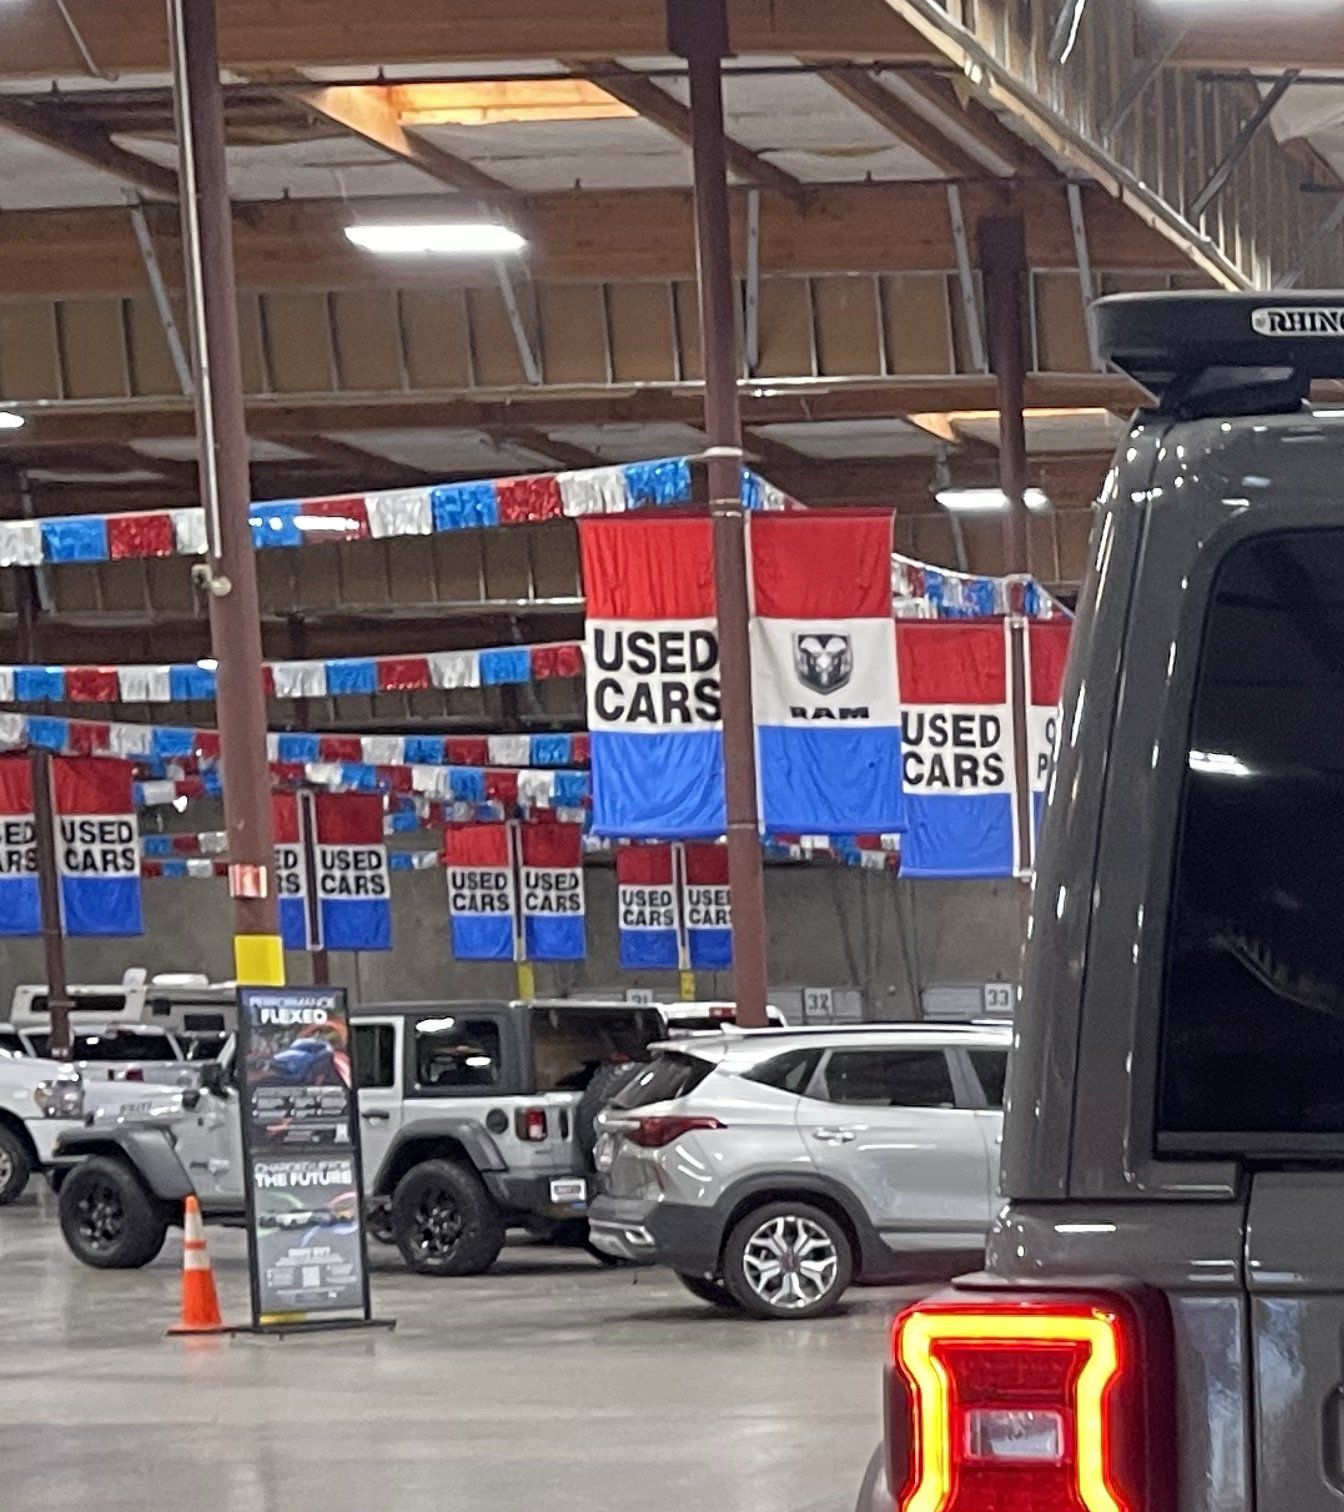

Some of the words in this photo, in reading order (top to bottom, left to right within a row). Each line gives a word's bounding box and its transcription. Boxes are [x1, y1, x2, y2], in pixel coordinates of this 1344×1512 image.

[594, 627, 720, 675] USED
[594, 677, 722, 724] CARS
[790, 706, 870, 719] RAM
[900, 711, 1001, 748] USED
[902, 751, 1005, 788] CARS
[60, 820, 134, 844] USED
[65, 849, 136, 872] CARS
[320, 850, 382, 871] USED
[320, 874, 386, 895] CARS
[452, 871, 508, 891] USED
[525, 871, 579, 891] USED
[452, 893, 510, 913] CARS
[525, 893, 581, 913] CARS
[622, 889, 672, 907] USED
[688, 889, 731, 906] USE
[623, 909, 674, 926] CARS
[688, 909, 732, 925] CAR
